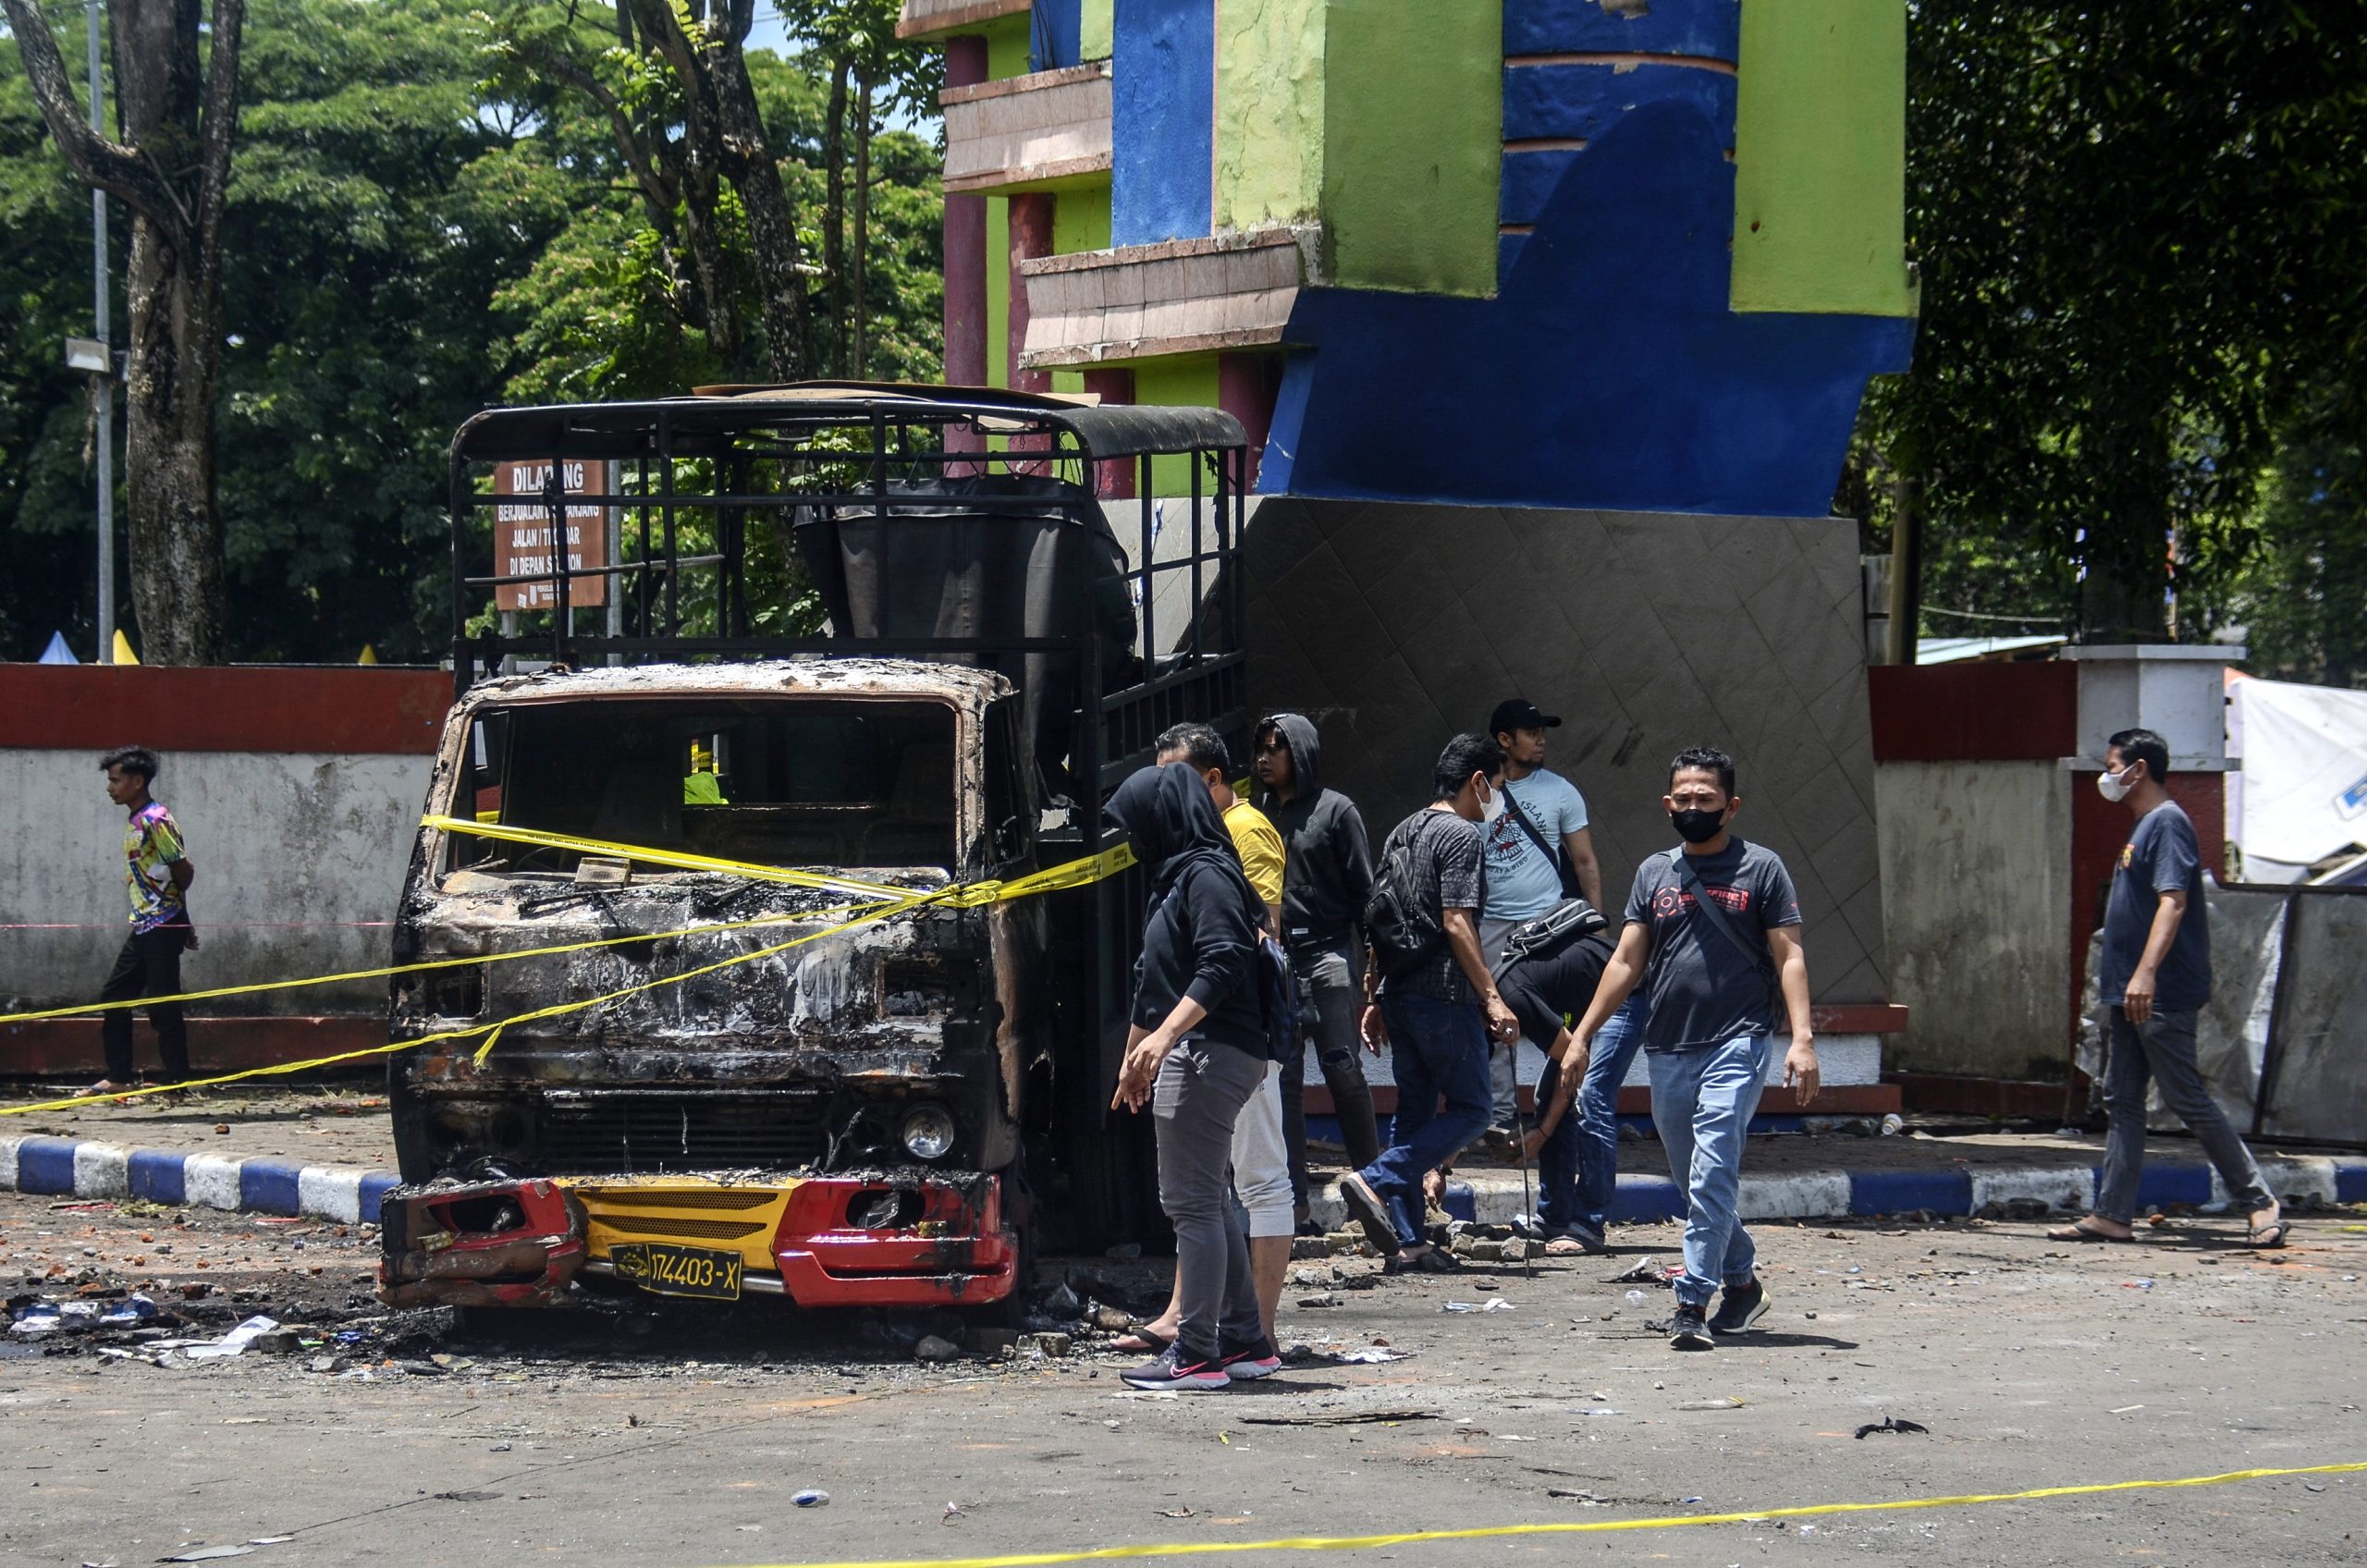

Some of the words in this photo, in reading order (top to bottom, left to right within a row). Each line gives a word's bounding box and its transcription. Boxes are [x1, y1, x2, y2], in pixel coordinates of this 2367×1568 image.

[513, 462, 583, 492] DILANG
[512, 528, 537, 547] JALAN
[510, 557, 519, 575] DI
[520, 556, 545, 575] DEPAN
[1512, 856, 1528, 871] BIRD
[652, 1253, 738, 1290] 174403-X
